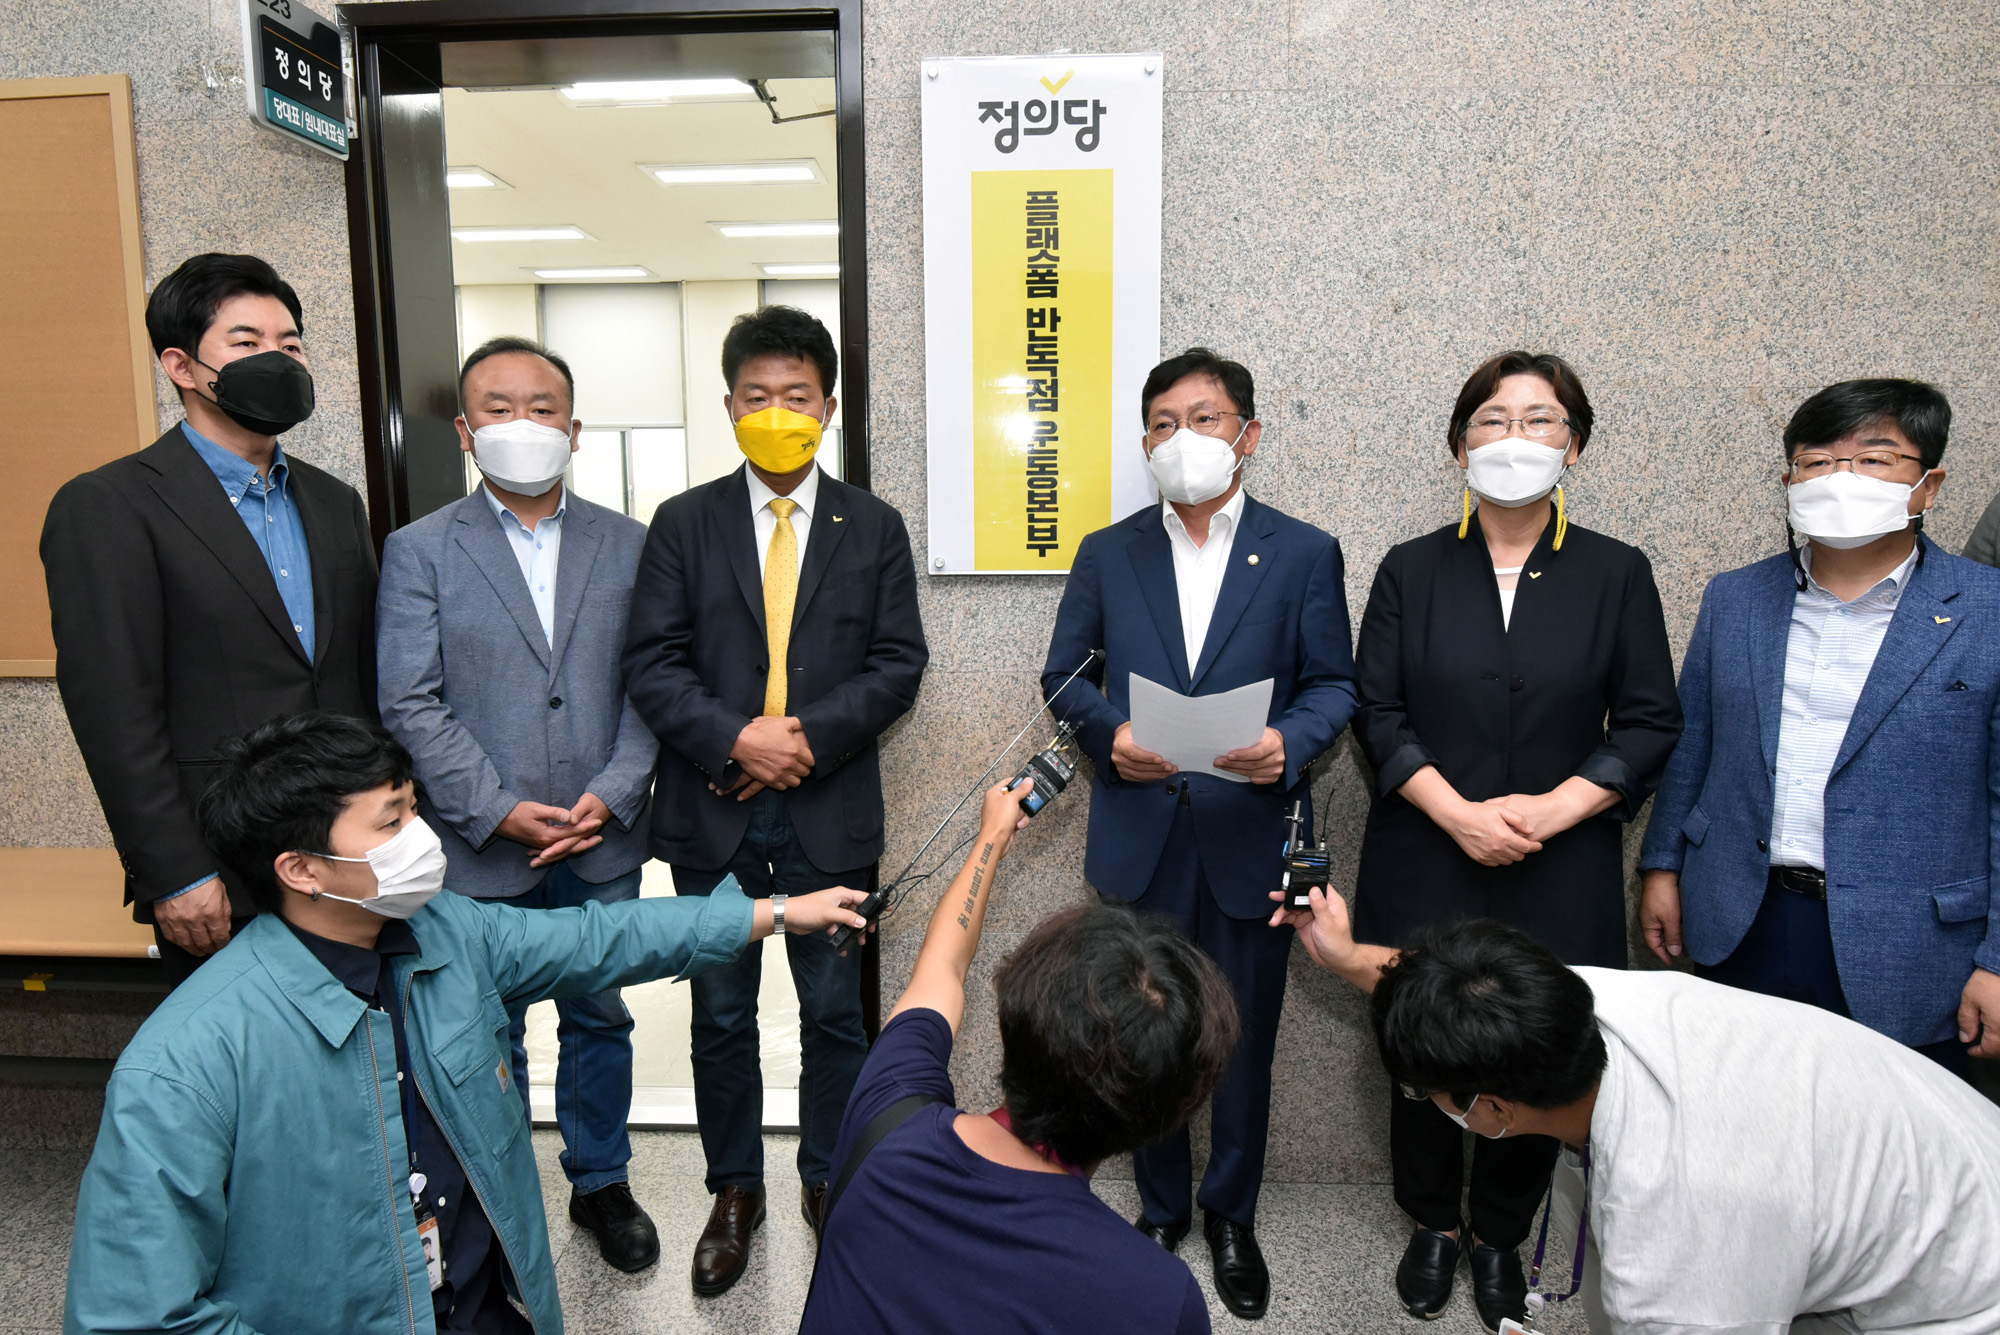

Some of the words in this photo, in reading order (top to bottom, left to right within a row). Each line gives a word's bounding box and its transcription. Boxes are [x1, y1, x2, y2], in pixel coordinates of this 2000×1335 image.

[256, 0, 291, 19] 23
[978, 98, 1107, 154] 정의당
[1025, 191, 1060, 298] 플랫폼
[1026, 307, 1061, 412] 반독점
[1026, 421, 1059, 557] 운동본부
